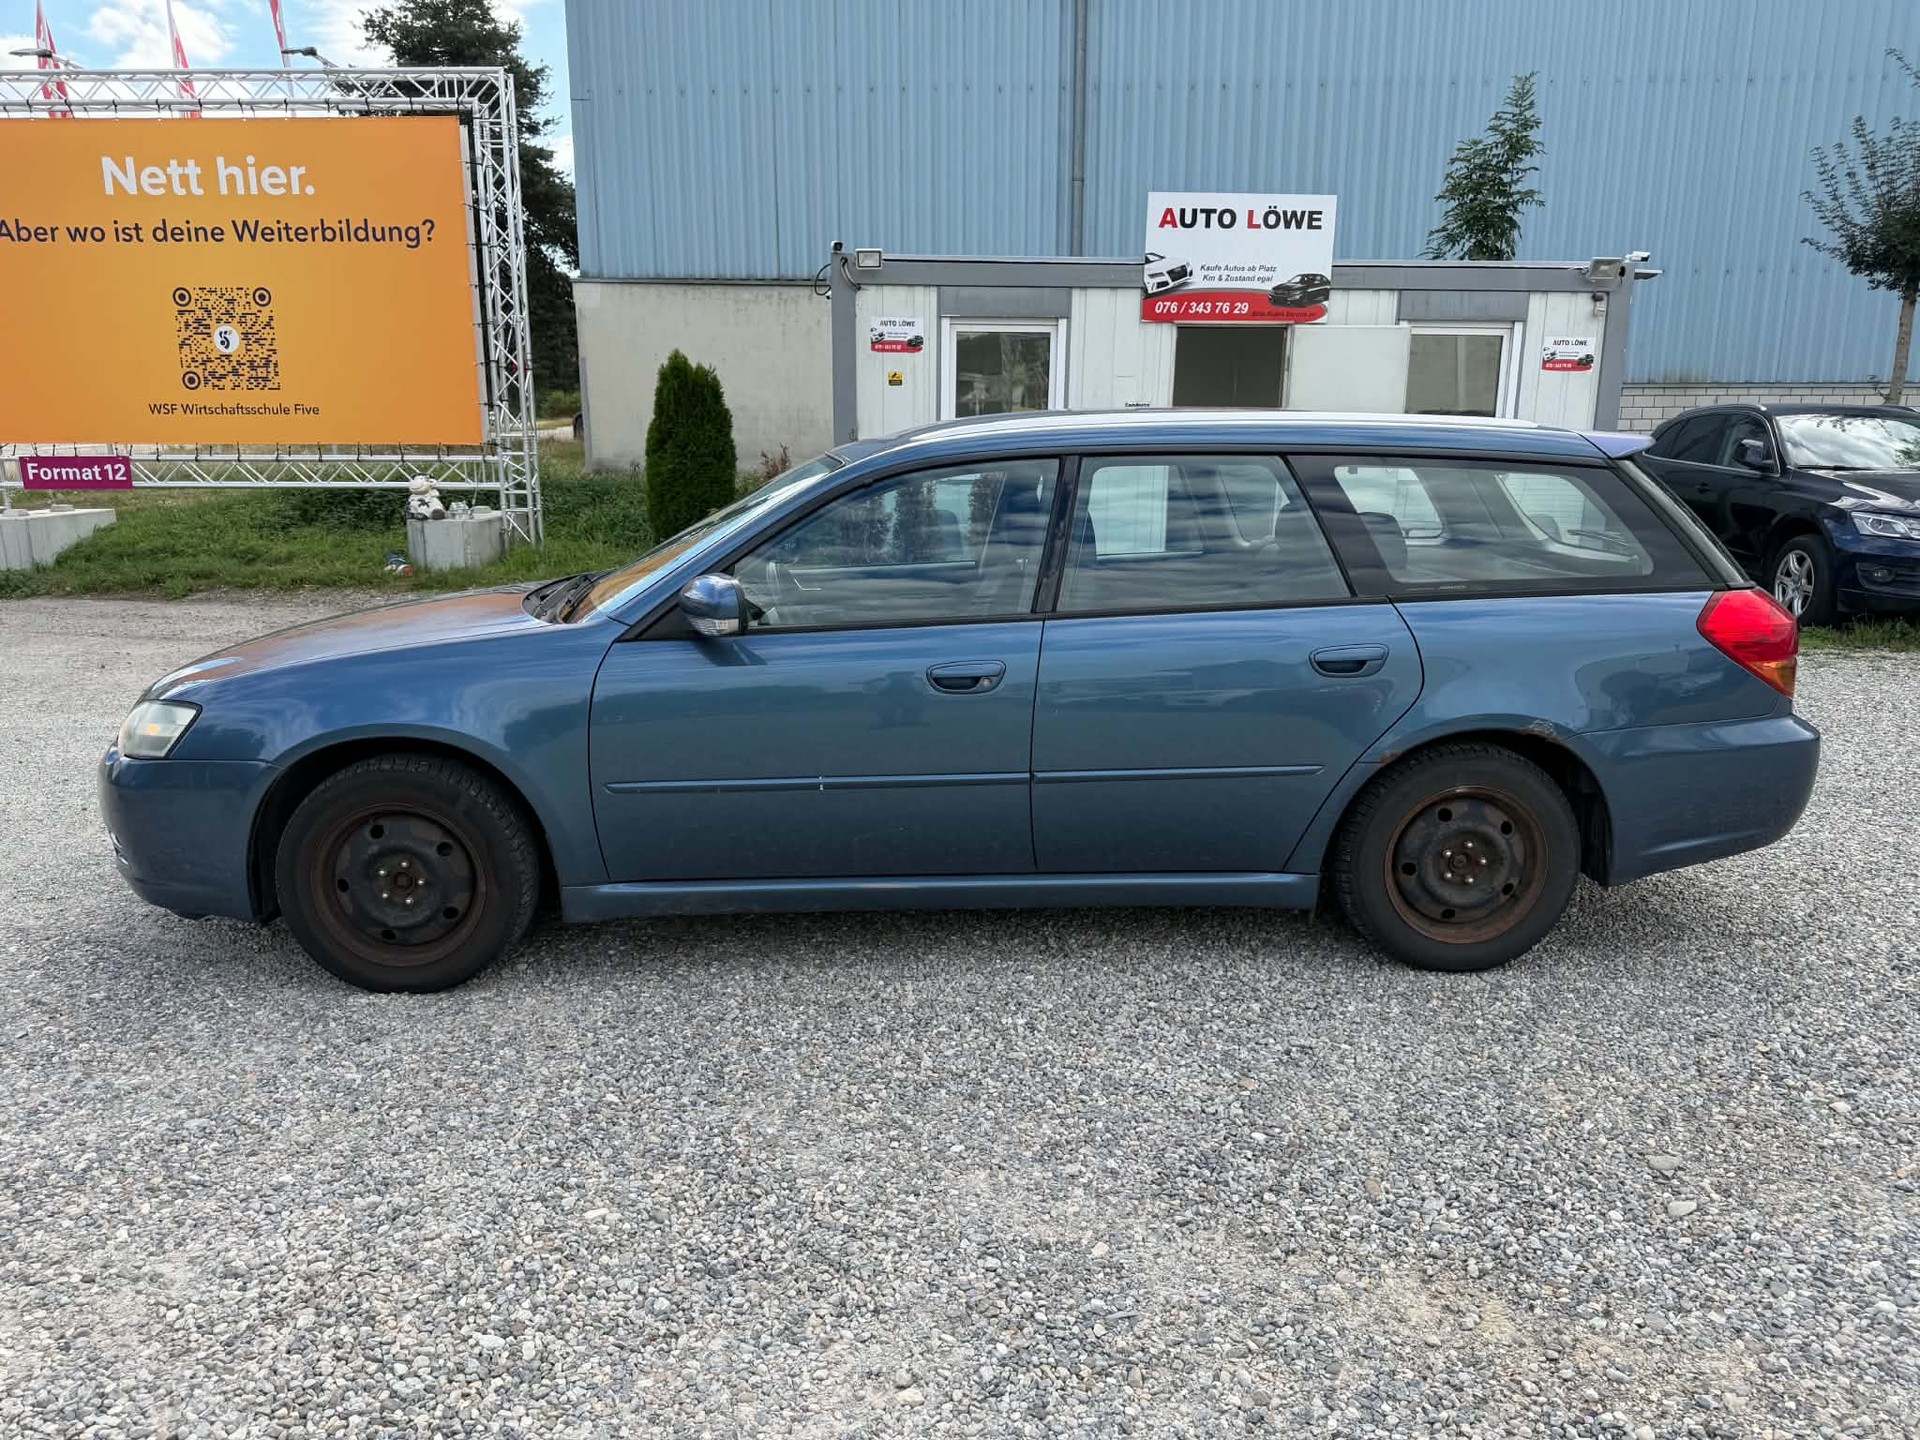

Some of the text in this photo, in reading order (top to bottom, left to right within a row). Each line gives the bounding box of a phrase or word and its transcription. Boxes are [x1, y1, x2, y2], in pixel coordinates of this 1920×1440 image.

[101, 155, 315, 195] Nett hier.
[1158, 205, 1323, 230] AUTO LÖWE
[0, 218, 435, 249] Aber wo ist deine Weiterbildung?
[1199, 264, 1277, 272] Kaufe Autos ab Platz
[1225, 274, 1256, 282] Zustand
[1257, 275, 1274, 283] egal
[1155, 301, 1178, 314] 076
[1180, 302, 1187, 314] /
[1188, 302, 1212, 314] 343
[1215, 302, 1230, 314] 76
[1233, 302, 1249, 314] 29
[148, 402, 320, 416] WSF Wirtschaftsschule Five
